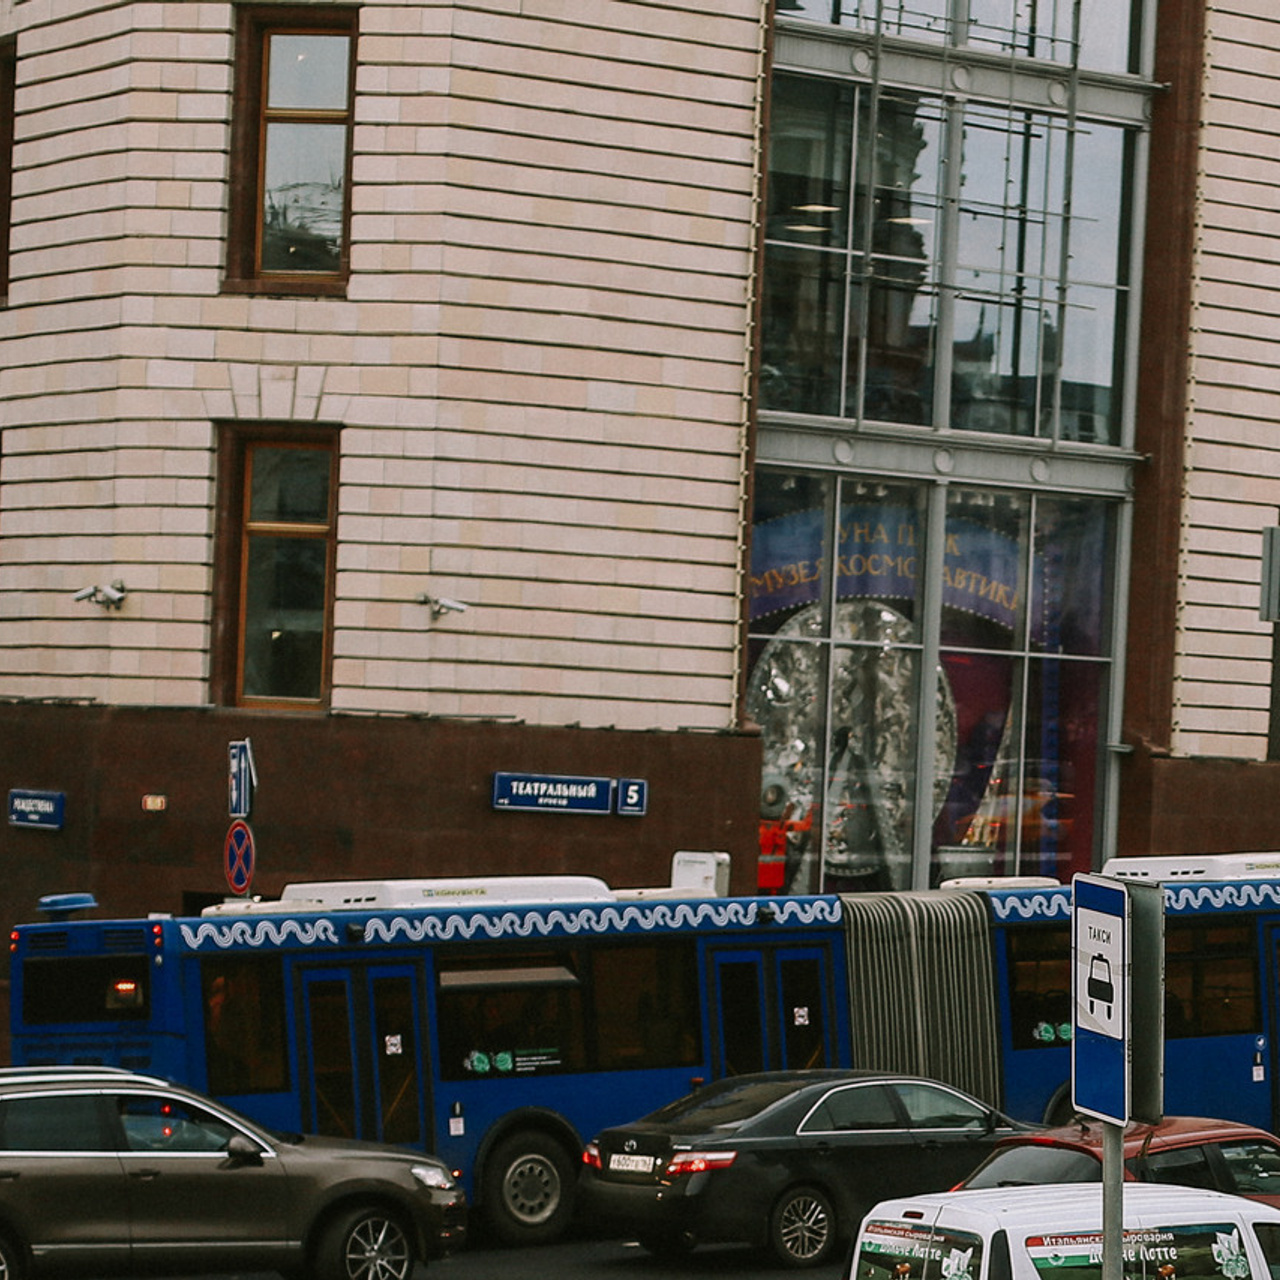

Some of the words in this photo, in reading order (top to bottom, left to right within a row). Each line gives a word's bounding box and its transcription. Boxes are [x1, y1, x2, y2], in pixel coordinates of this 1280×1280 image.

[819, 521, 890, 547] УНА
[511, 781, 597, 798] ТЕАТРАЛЬНЫЙ
[626, 785, 640, 804] 5
[1088, 926, 1112, 945] ТАКСИ
